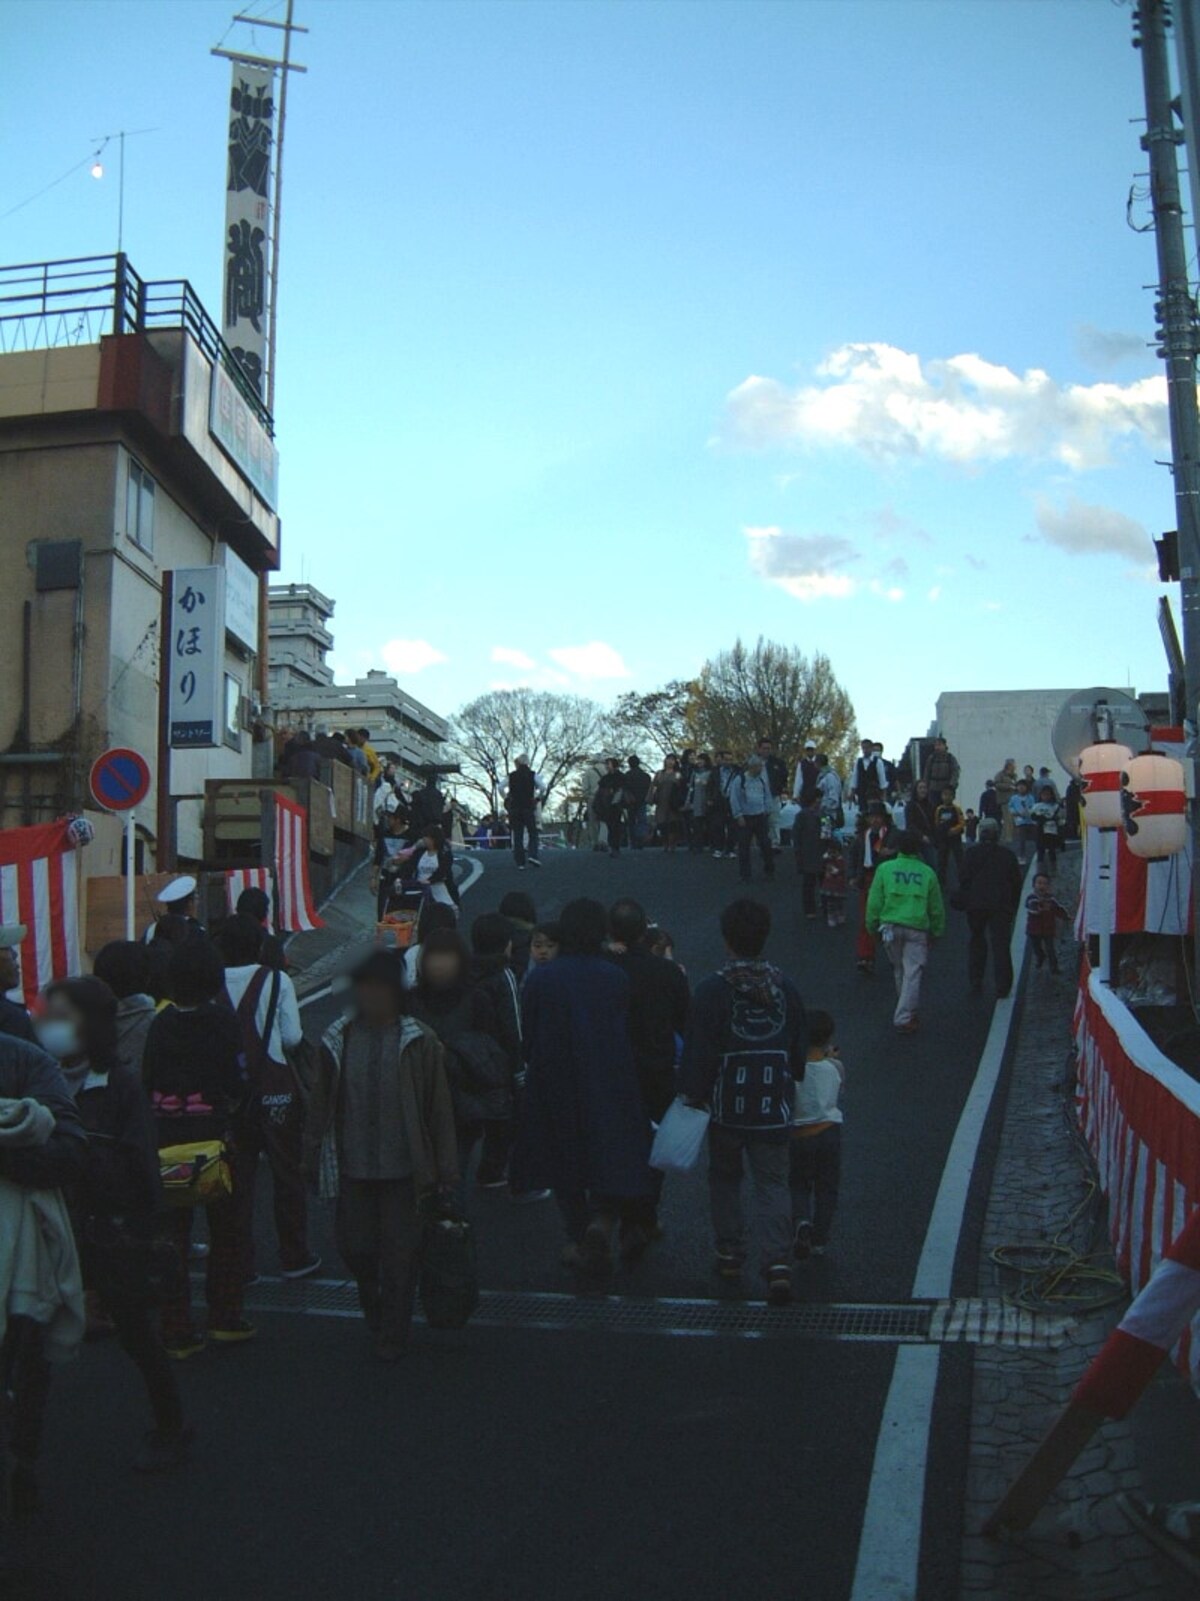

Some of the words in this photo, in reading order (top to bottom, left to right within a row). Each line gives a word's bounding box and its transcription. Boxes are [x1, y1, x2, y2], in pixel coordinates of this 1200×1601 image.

[177, 586, 206, 706] かほり
[893, 871, 924, 886] TVC
